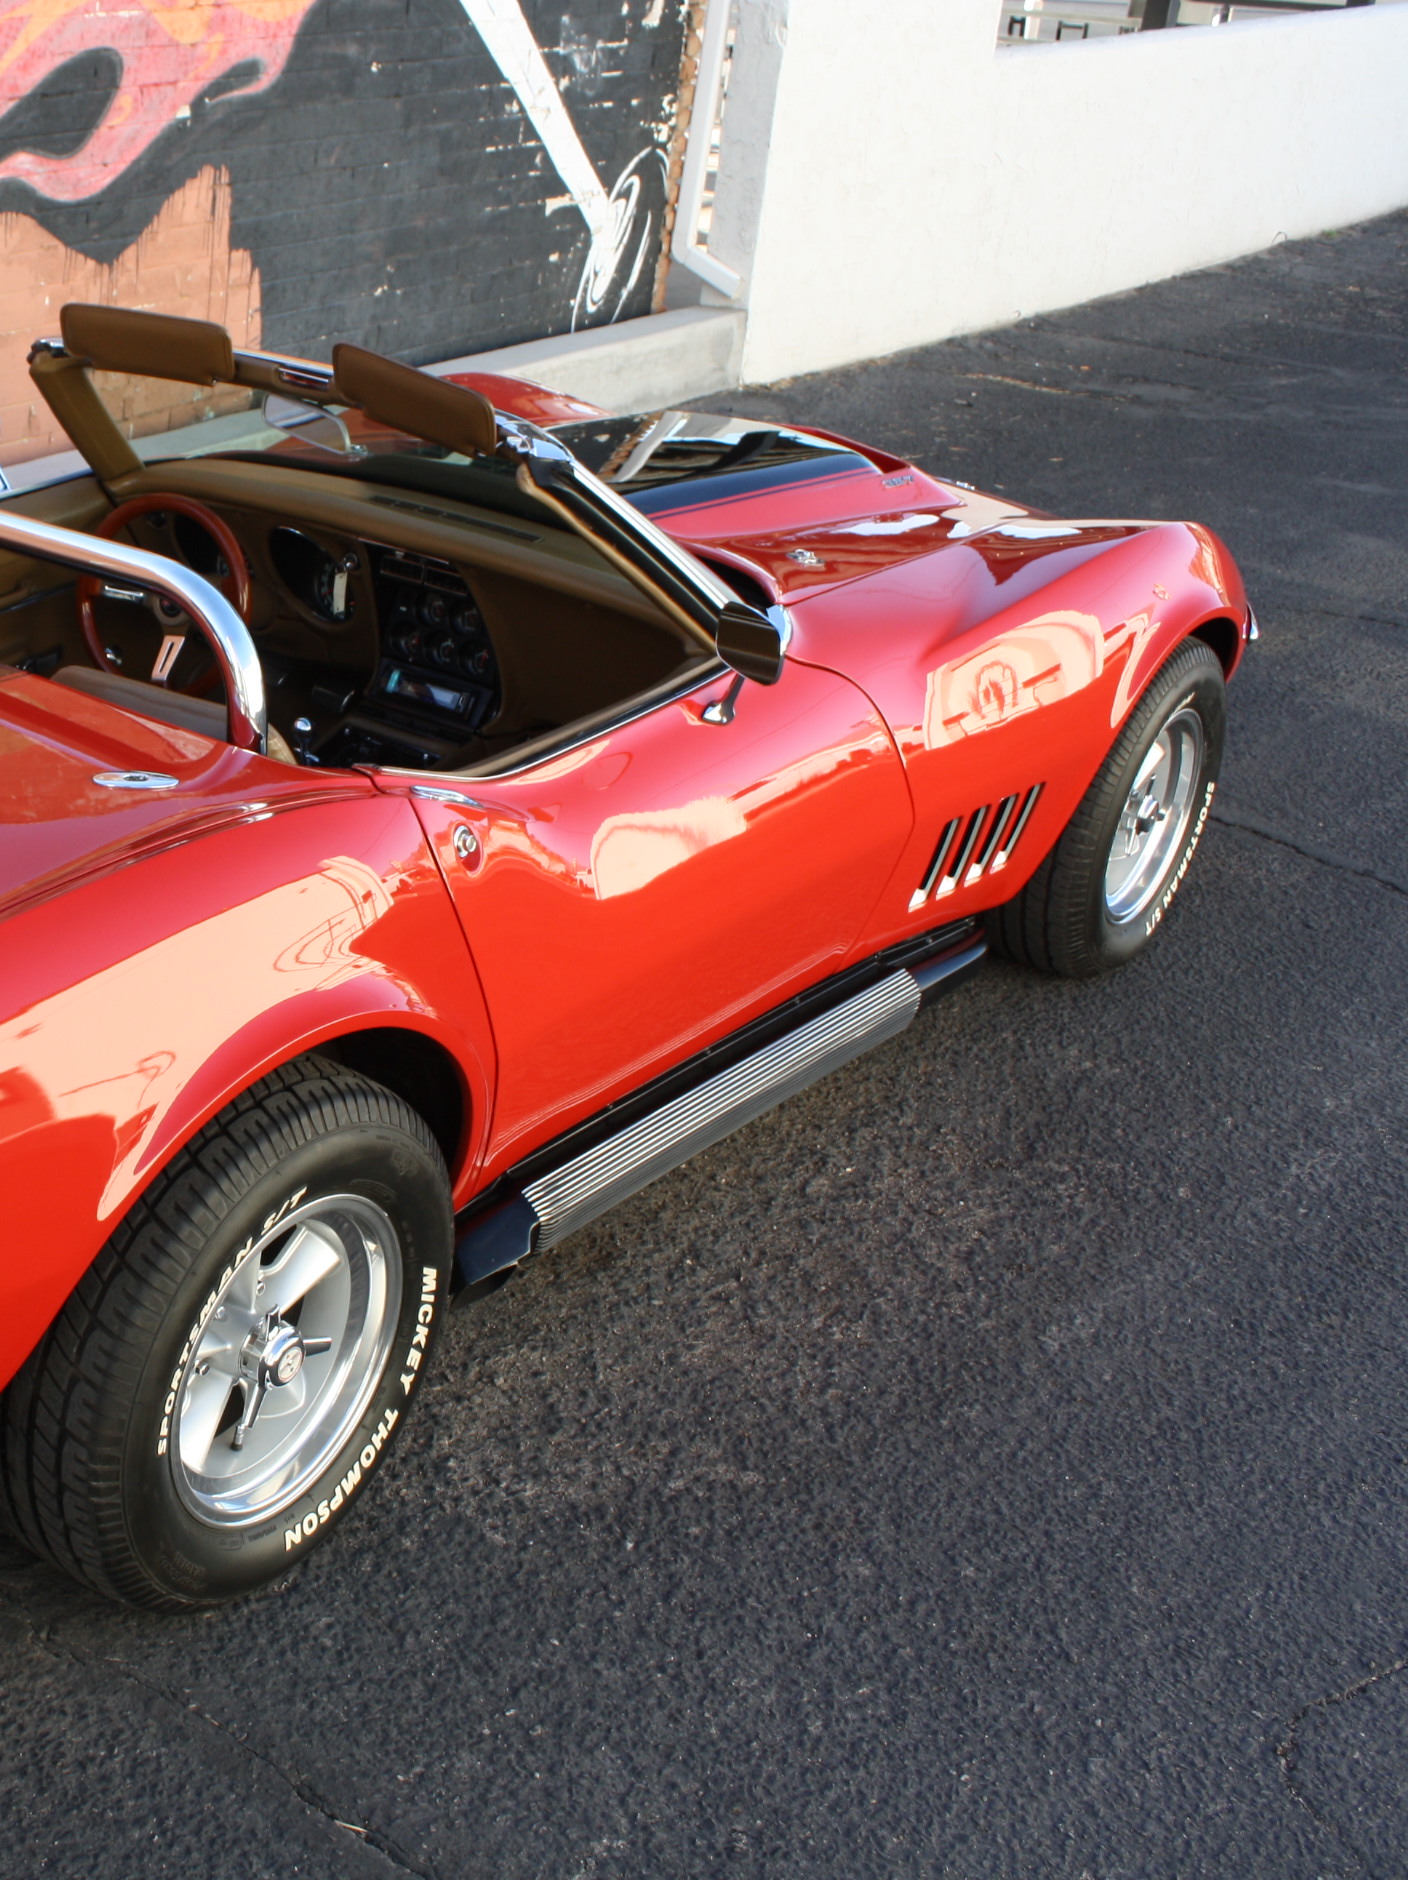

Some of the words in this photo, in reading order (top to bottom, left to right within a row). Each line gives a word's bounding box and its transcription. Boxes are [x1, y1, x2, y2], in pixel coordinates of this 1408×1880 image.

[1163, 782, 1216, 909] SPORTSMAN
[157, 1236, 253, 1456] SPORTSMAN
[399, 1266, 438, 1396] MICKEY
[285, 1408, 399, 1551] THOMPSON
